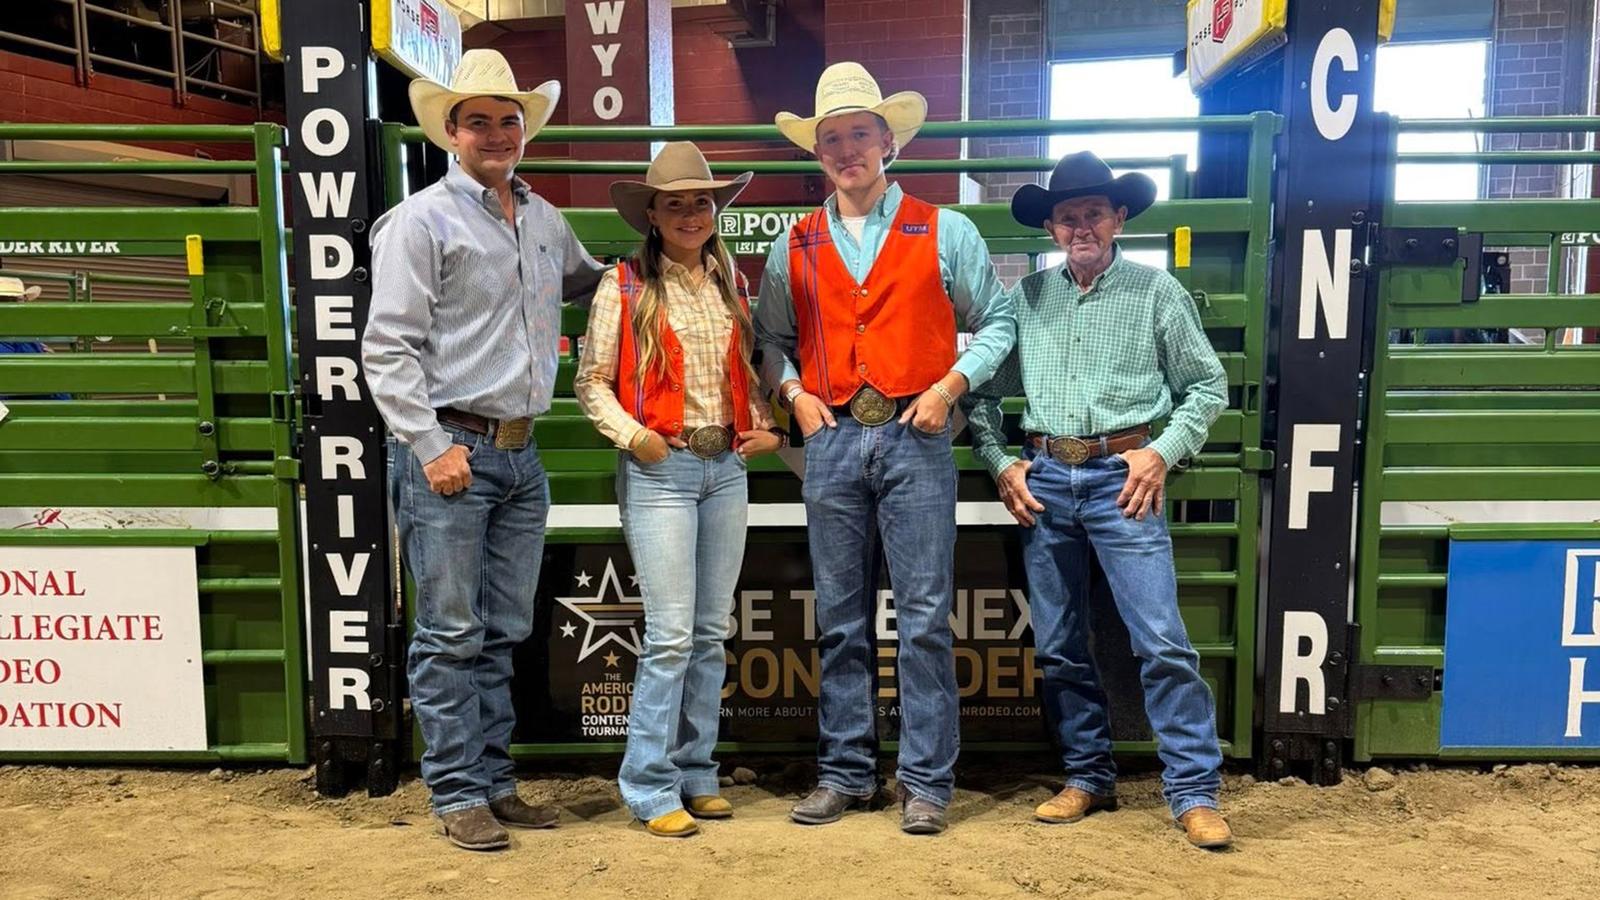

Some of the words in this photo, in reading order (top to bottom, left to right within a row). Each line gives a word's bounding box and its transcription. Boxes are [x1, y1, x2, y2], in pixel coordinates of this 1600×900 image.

[584, 1, 625, 120] WYO
[48, 241, 121, 253] RIVER
[299, 46, 362, 401] POWDER
[1279, 27, 1359, 715] CNFR
[320, 436, 372, 711] RIVER
[605, 673, 621, 681] THE
[738, 706, 770, 717] MORE
[774, 706, 814, 717] ABOUT
[960, 706, 1041, 718] NRODEO.COM
